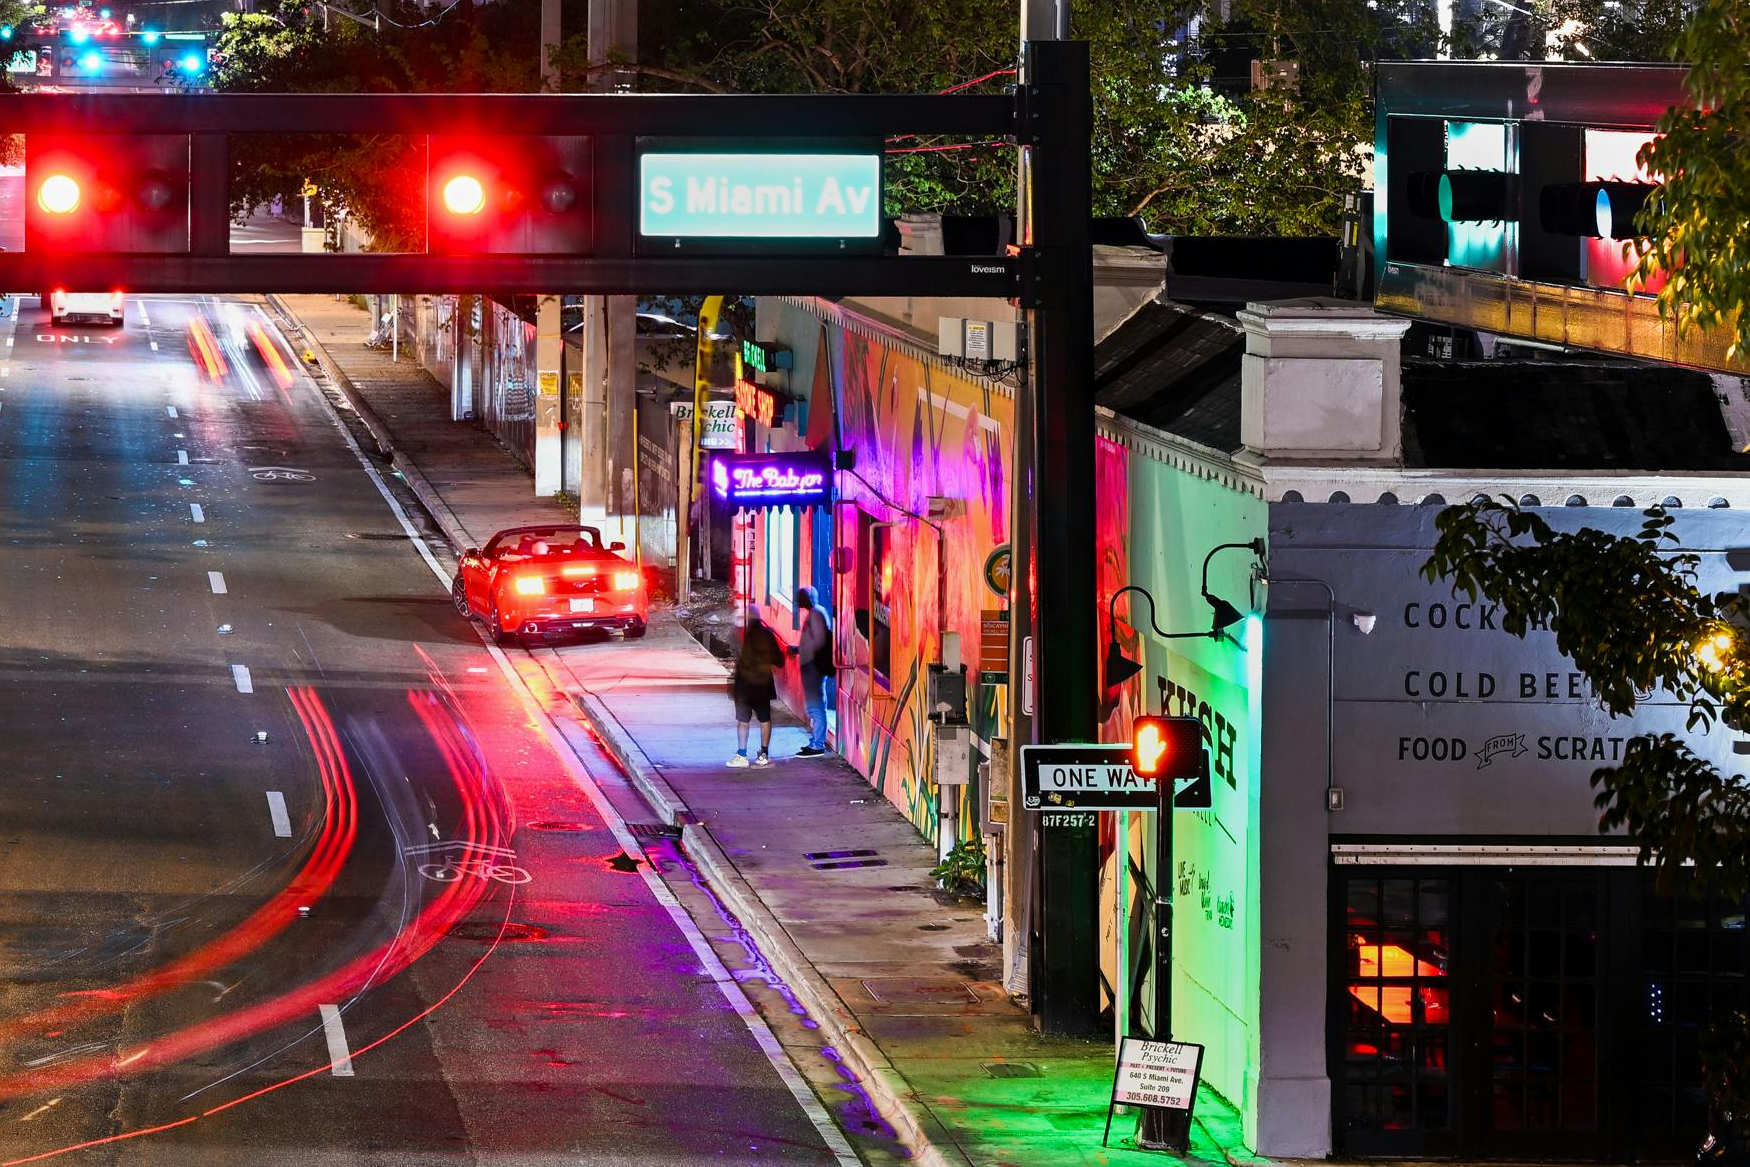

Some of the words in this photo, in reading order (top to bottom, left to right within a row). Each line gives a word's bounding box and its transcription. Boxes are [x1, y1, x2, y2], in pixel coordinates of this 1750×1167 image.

[649, 176, 674, 214] S
[686, 177, 803, 215] Miami
[815, 177, 871, 215] Av
[971, 265, 1005, 274] loveism
[36, 334, 118, 344] ONLY
[743, 340, 767, 372] BRCKELL
[675, 405, 736, 419] Brckell
[733, 467, 763, 489] The
[762, 466, 823, 491] Babyon
[1404, 671, 1496, 697] COLD
[1399, 737, 1467, 761] FOOD
[1486, 738, 1515, 754] FROM
[1537, 736, 1626, 761] SCRAT
[1053, 768, 1098, 787] ONE
[1107, 768, 1153, 787] WA
[1140, 1040, 1184, 1055] Brickell
[1141, 1051, 1178, 1064] Psychic
[1129, 1071, 1142, 1079] 640
[1148, 1074, 1169, 1082] Miami
[1169, 1076, 1184, 1084] Ave.
[1140, 1083, 1155, 1091] Suite
[1157, 1085, 1170, 1093] 209
[1126, 1092, 1181, 1106] 305.608.5752
